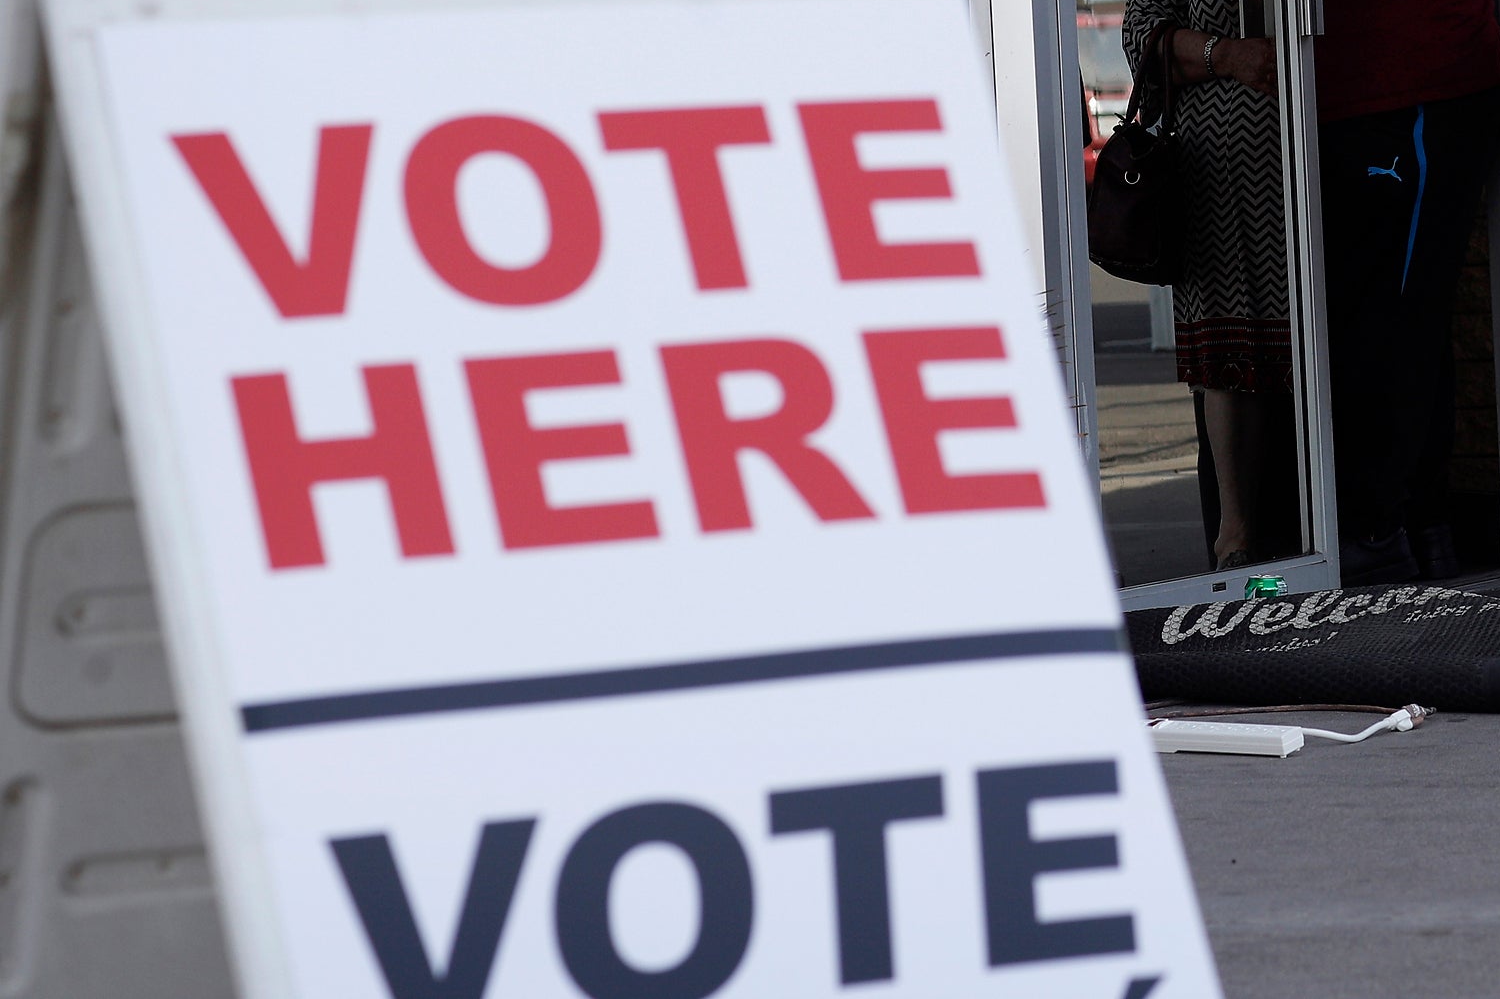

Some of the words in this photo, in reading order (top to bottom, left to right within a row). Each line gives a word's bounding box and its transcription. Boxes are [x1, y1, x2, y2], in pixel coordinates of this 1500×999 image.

[168, 97, 985, 320] VOTE
[227, 324, 1049, 571] HERE
[326, 759, 1140, 999] VOTE
